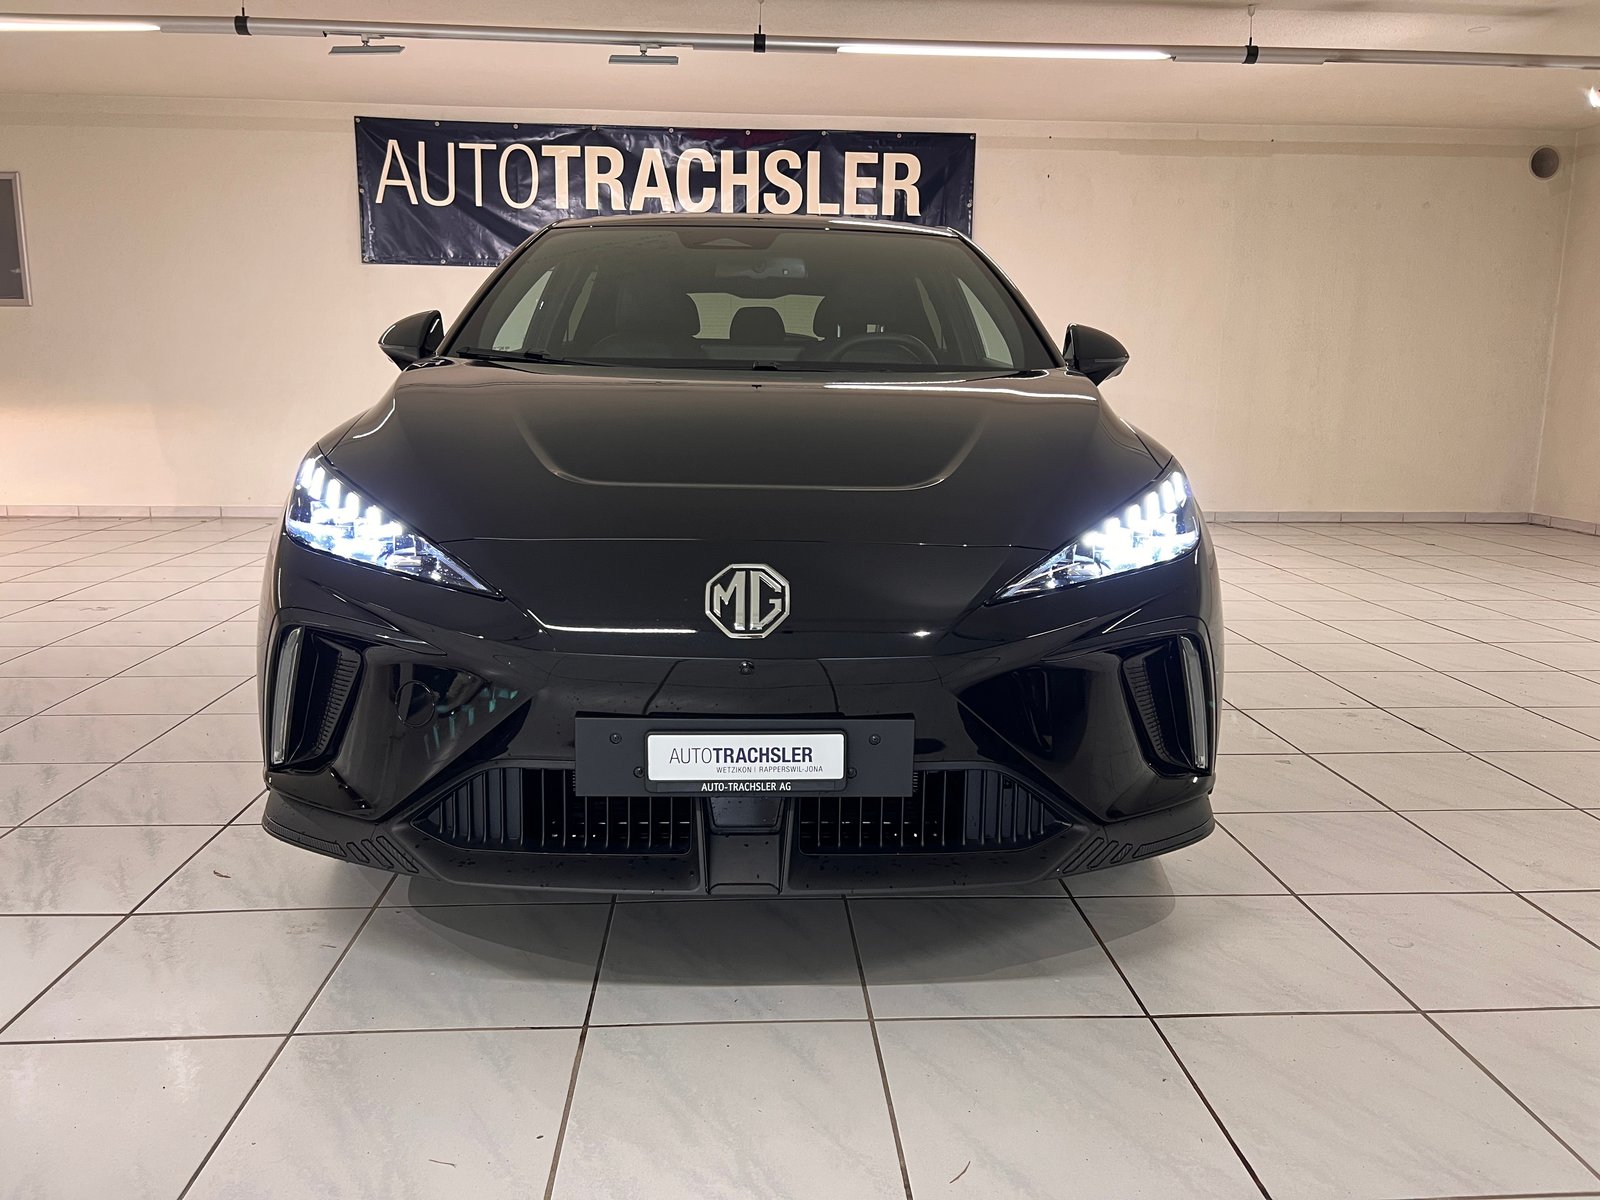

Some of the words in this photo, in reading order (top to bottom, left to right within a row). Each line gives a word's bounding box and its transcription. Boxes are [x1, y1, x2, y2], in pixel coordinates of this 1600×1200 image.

[375, 138, 922, 217] AUTOTRACHSLER
[713, 570, 782, 631] MG
[669, 747, 813, 764] AUTOTRACHSLER
[716, 766, 752, 774] WETZIKON
[758, 765, 824, 773] RAPPERSWIL-JONA
[701, 782, 777, 792] AUTO-TRACHSLER
[779, 782, 792, 791] AG
